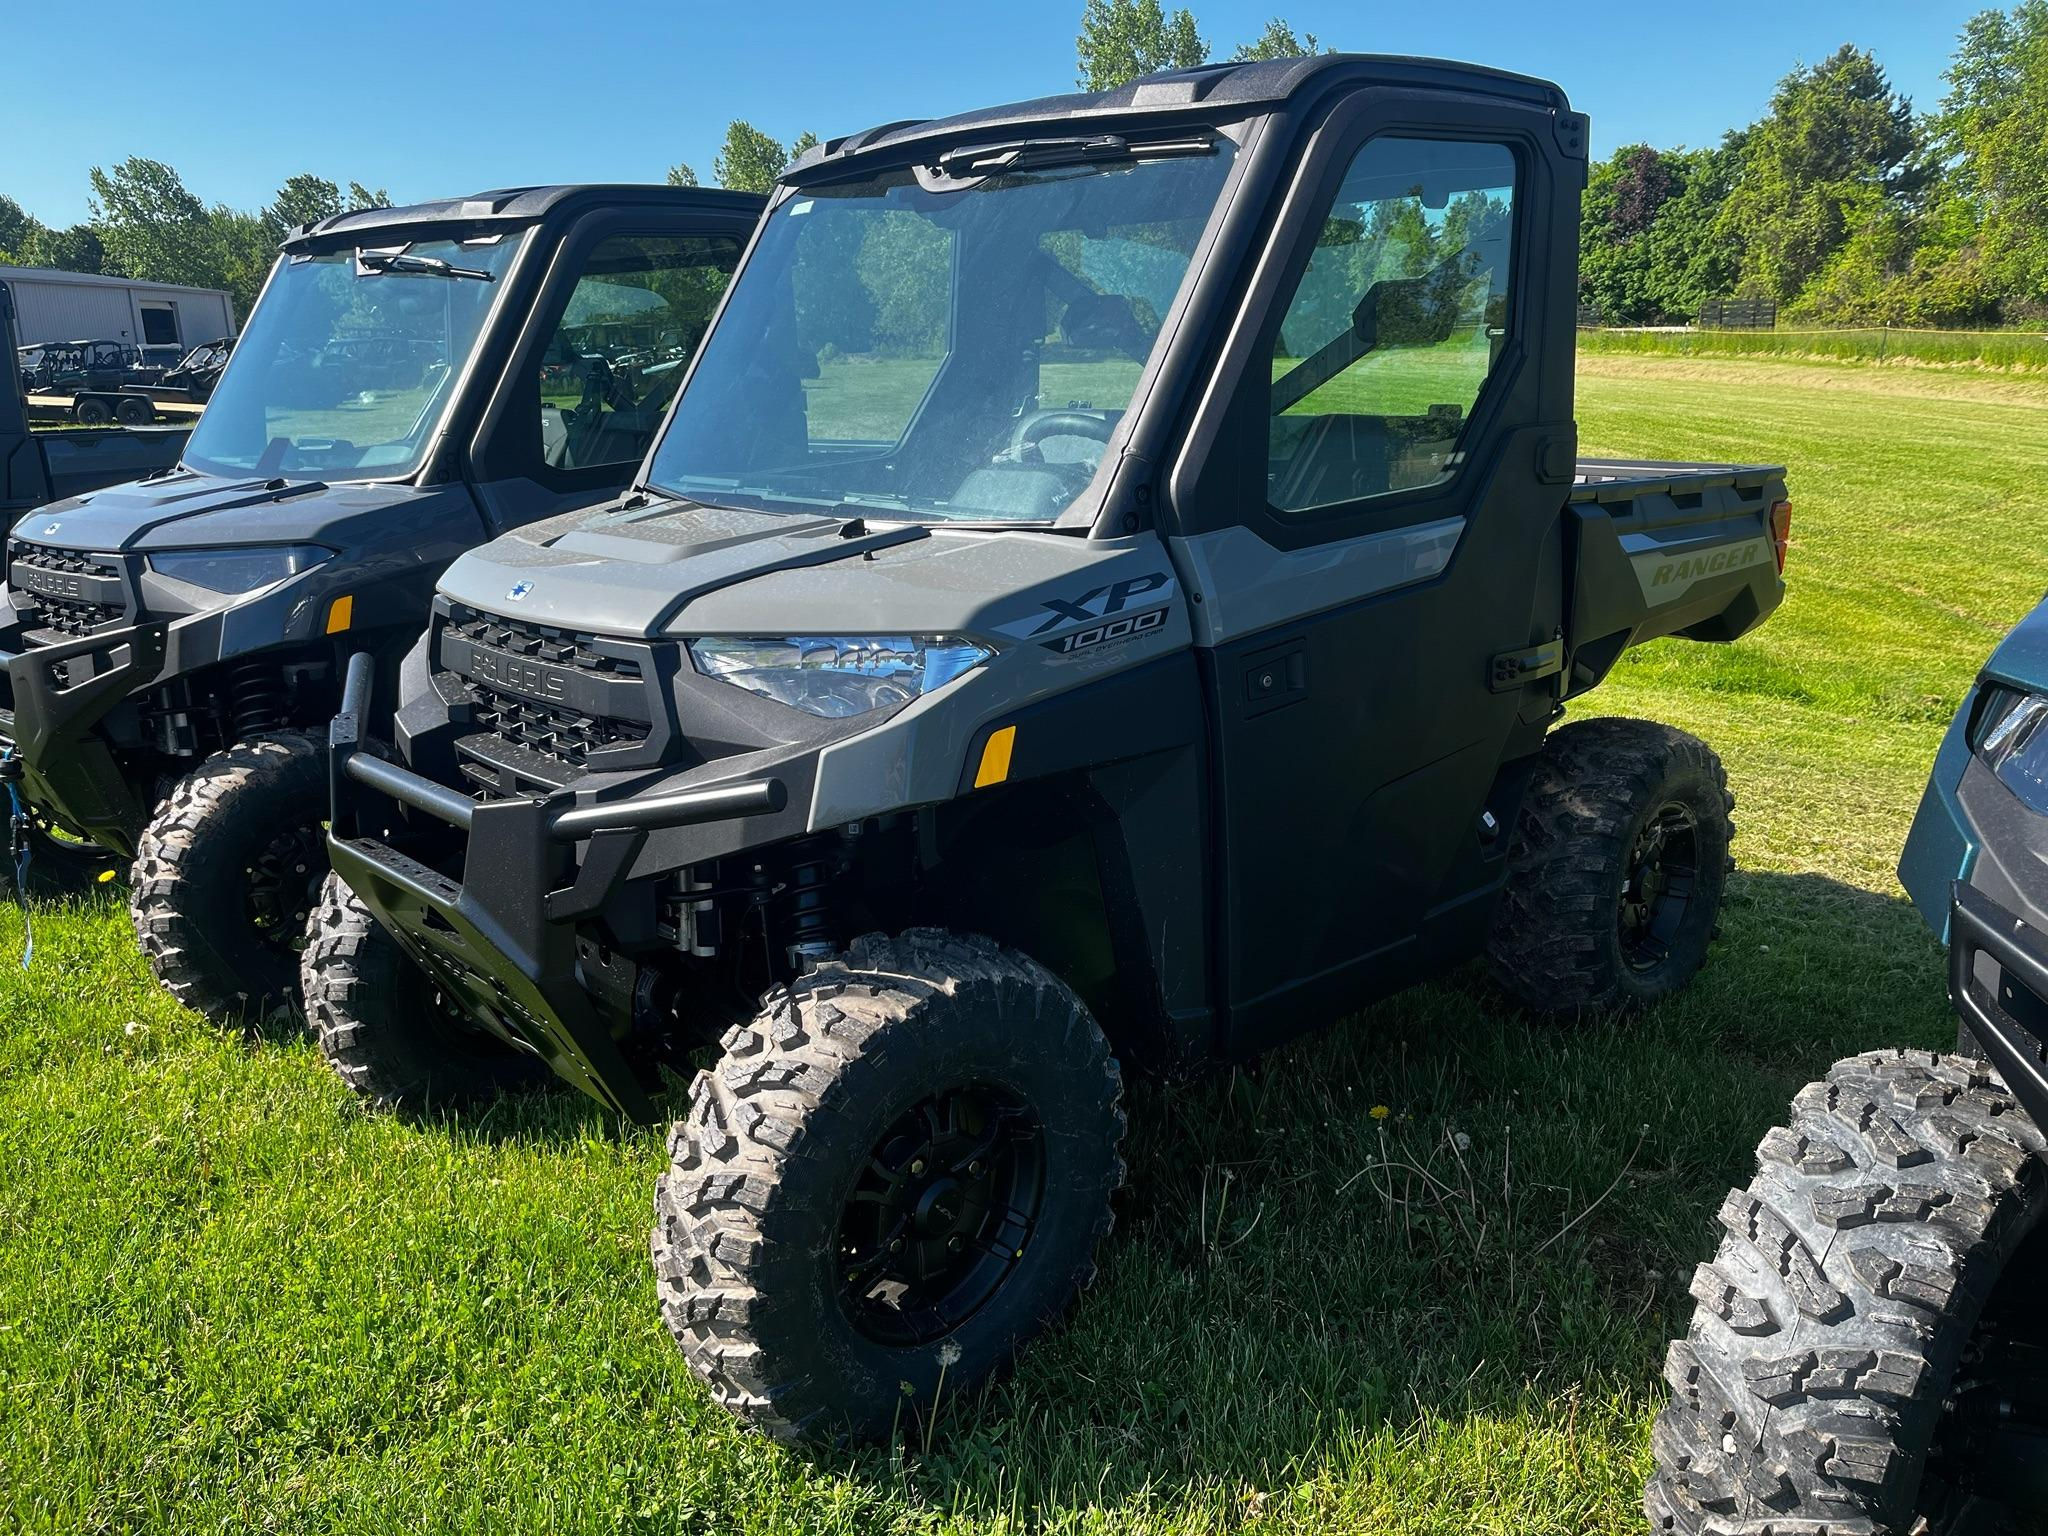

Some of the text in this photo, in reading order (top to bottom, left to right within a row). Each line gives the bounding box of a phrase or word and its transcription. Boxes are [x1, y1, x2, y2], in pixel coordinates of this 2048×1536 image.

[27, 570, 79, 596] POLARIS
[1651, 543, 1759, 587] RANGER
[1027, 572, 1169, 637] XP
[1063, 610, 1162, 653] 1000
[471, 649, 565, 700] POLARIS
